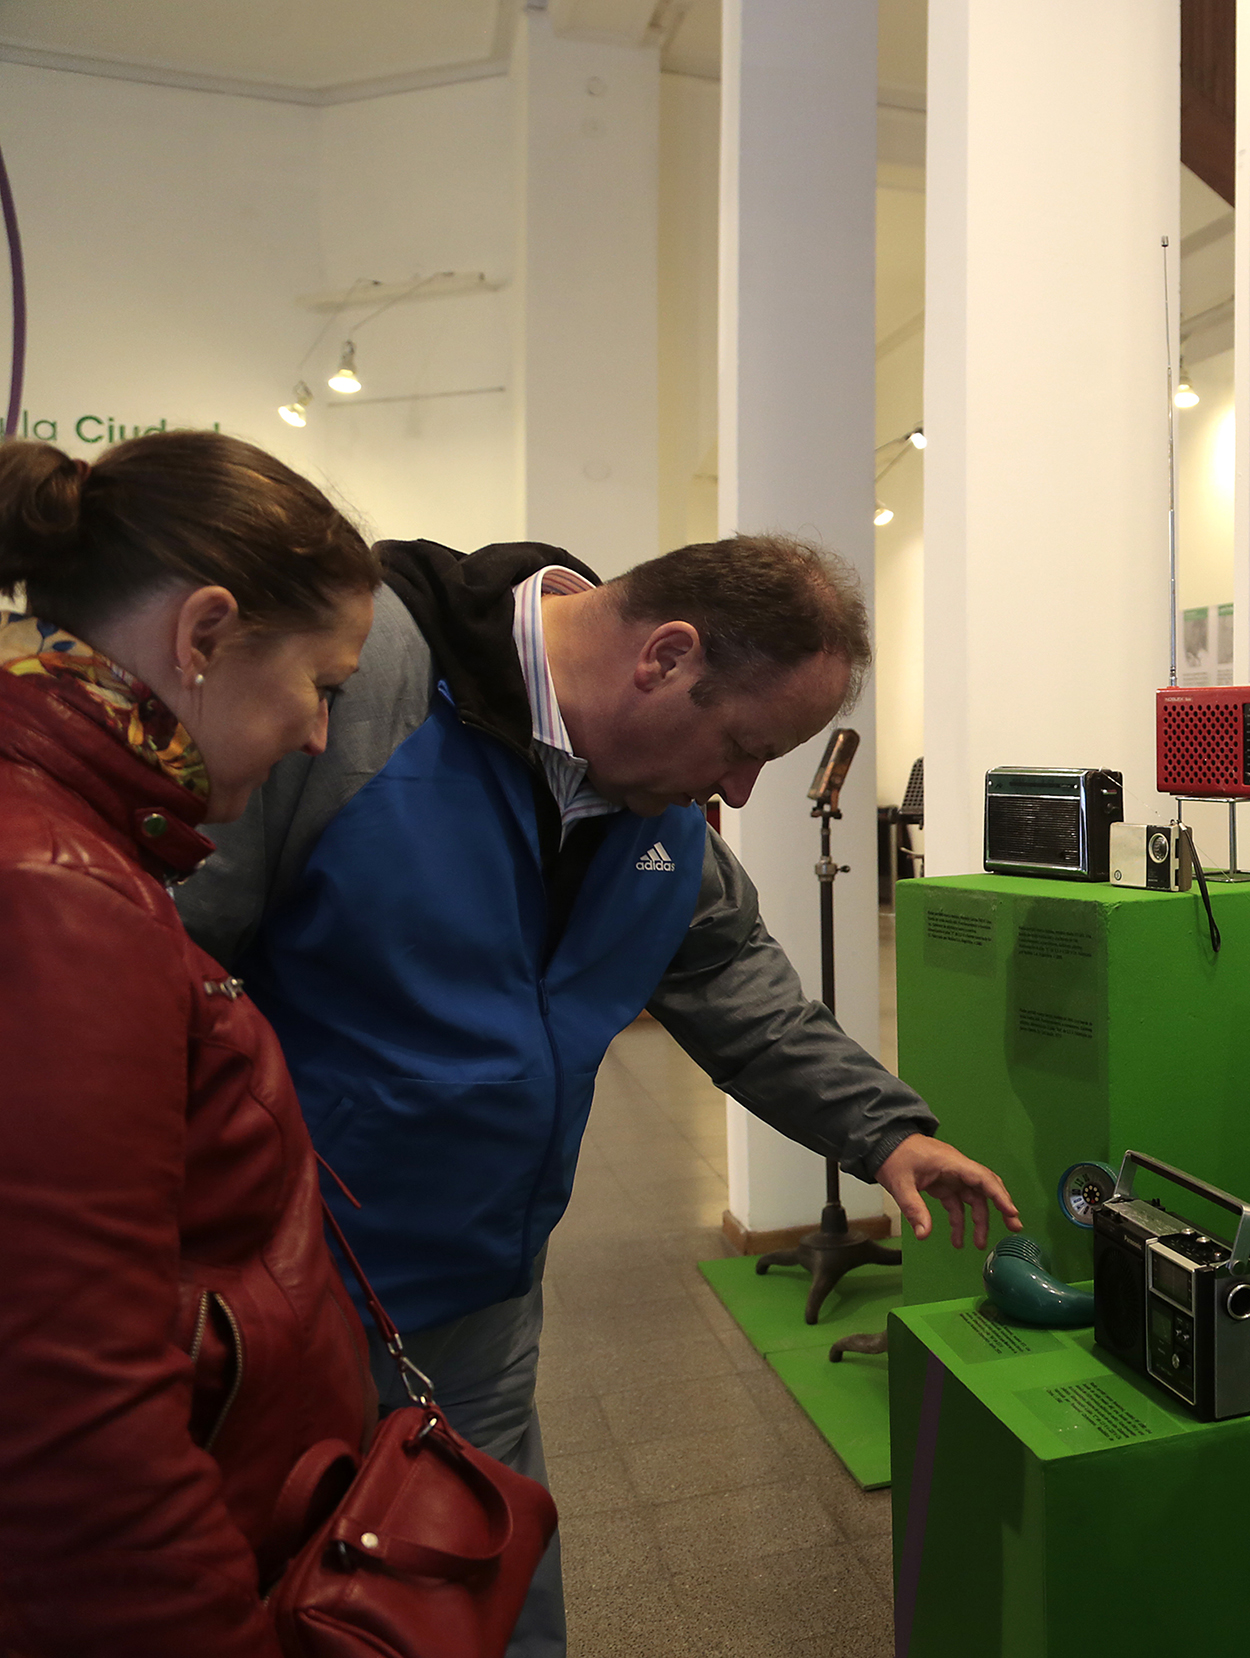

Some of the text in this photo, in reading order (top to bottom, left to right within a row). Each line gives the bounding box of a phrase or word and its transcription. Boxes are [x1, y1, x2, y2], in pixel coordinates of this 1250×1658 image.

[24, 410, 57, 440] la
[76, 415, 220, 443] Ciu
[635, 859, 676, 872] adidas
